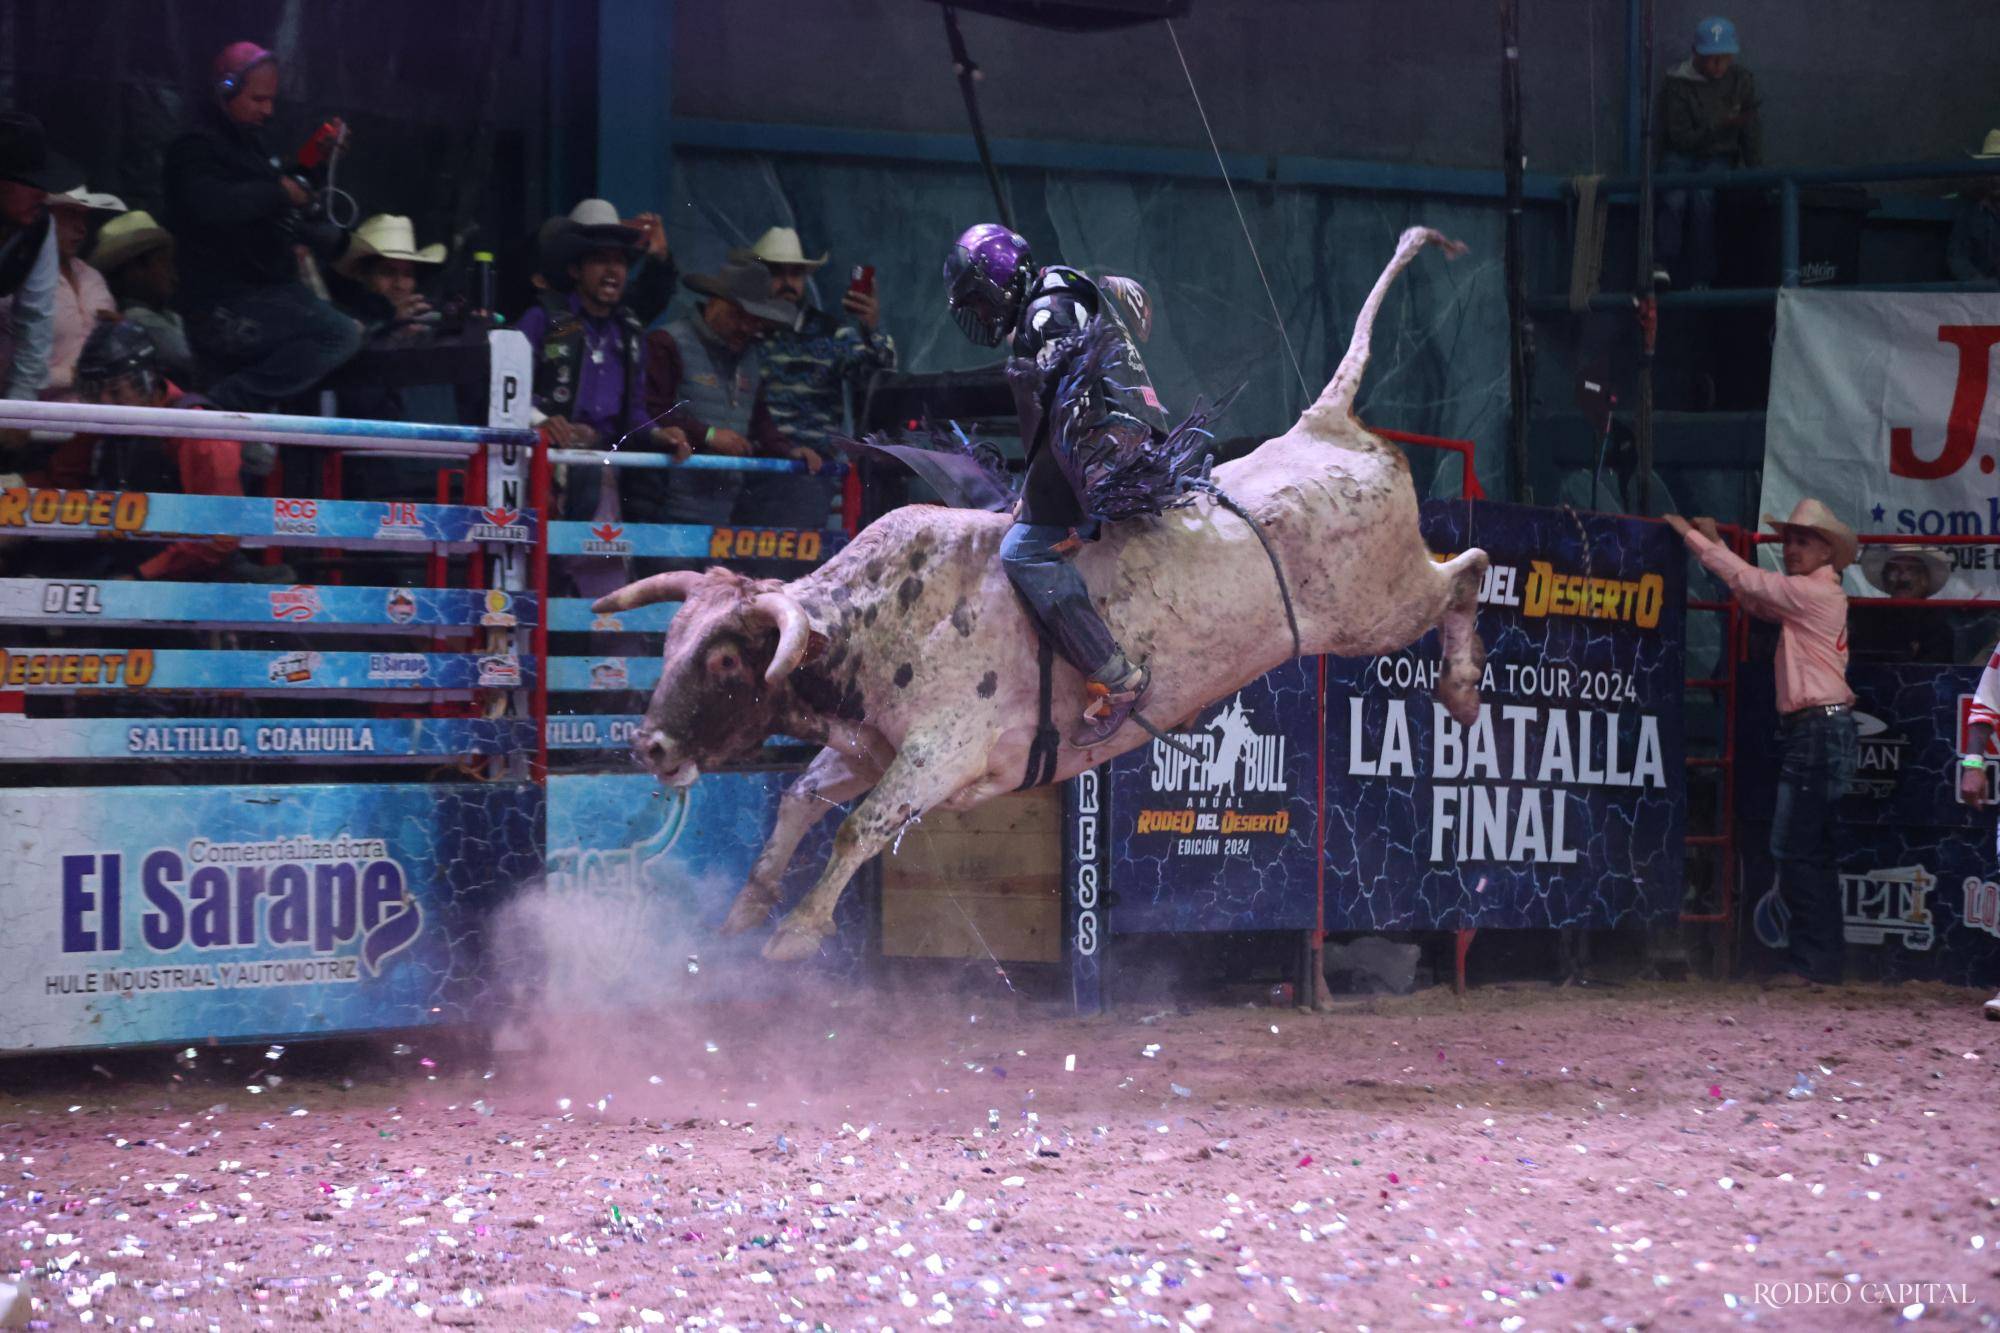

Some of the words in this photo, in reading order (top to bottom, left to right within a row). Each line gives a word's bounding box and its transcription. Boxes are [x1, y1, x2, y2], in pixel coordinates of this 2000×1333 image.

[0, 488, 149, 531] RODEO
[275, 500, 317, 519] RCG
[381, 503, 422, 526] JR
[274, 521, 317, 533] Media
[710, 527, 821, 560] RODEO
[43, 583, 103, 614] DEL
[1523, 560, 1664, 629] DESIERTO
[1377, 656, 1496, 693] COAHA
[1505, 664, 1570, 697] TOUR
[1580, 672, 1637, 702] 2024
[129, 727, 246, 755] SALTILLO,
[257, 727, 375, 751] COAHUILA
[1348, 697, 1414, 777] LA
[1431, 702, 1667, 788] BATALLA
[1151, 734, 1216, 791] SUPER
[1244, 734, 1287, 791] BULL
[1186, 798, 1243, 808] ANUAL
[1137, 810, 1196, 834] RODEO
[1196, 814, 1219, 830] DEL
[1221, 811, 1289, 834] DESIERTO
[1430, 785, 1577, 864] FINAL
[190, 838, 385, 862] Comercializadora
[1178, 836, 1218, 855] EDICIÓN
[1224, 839, 1249, 855] 2024
[1078, 770, 1099, 955] RESS
[62, 854, 121, 953] El
[142, 850, 420, 970] Sarape
[46, 973, 98, 995] HULE
[103, 967, 214, 992] INDUSTRIAL
[220, 966, 232, 985] Y
[235, 960, 358, 985] AUTOMOTRIZ
